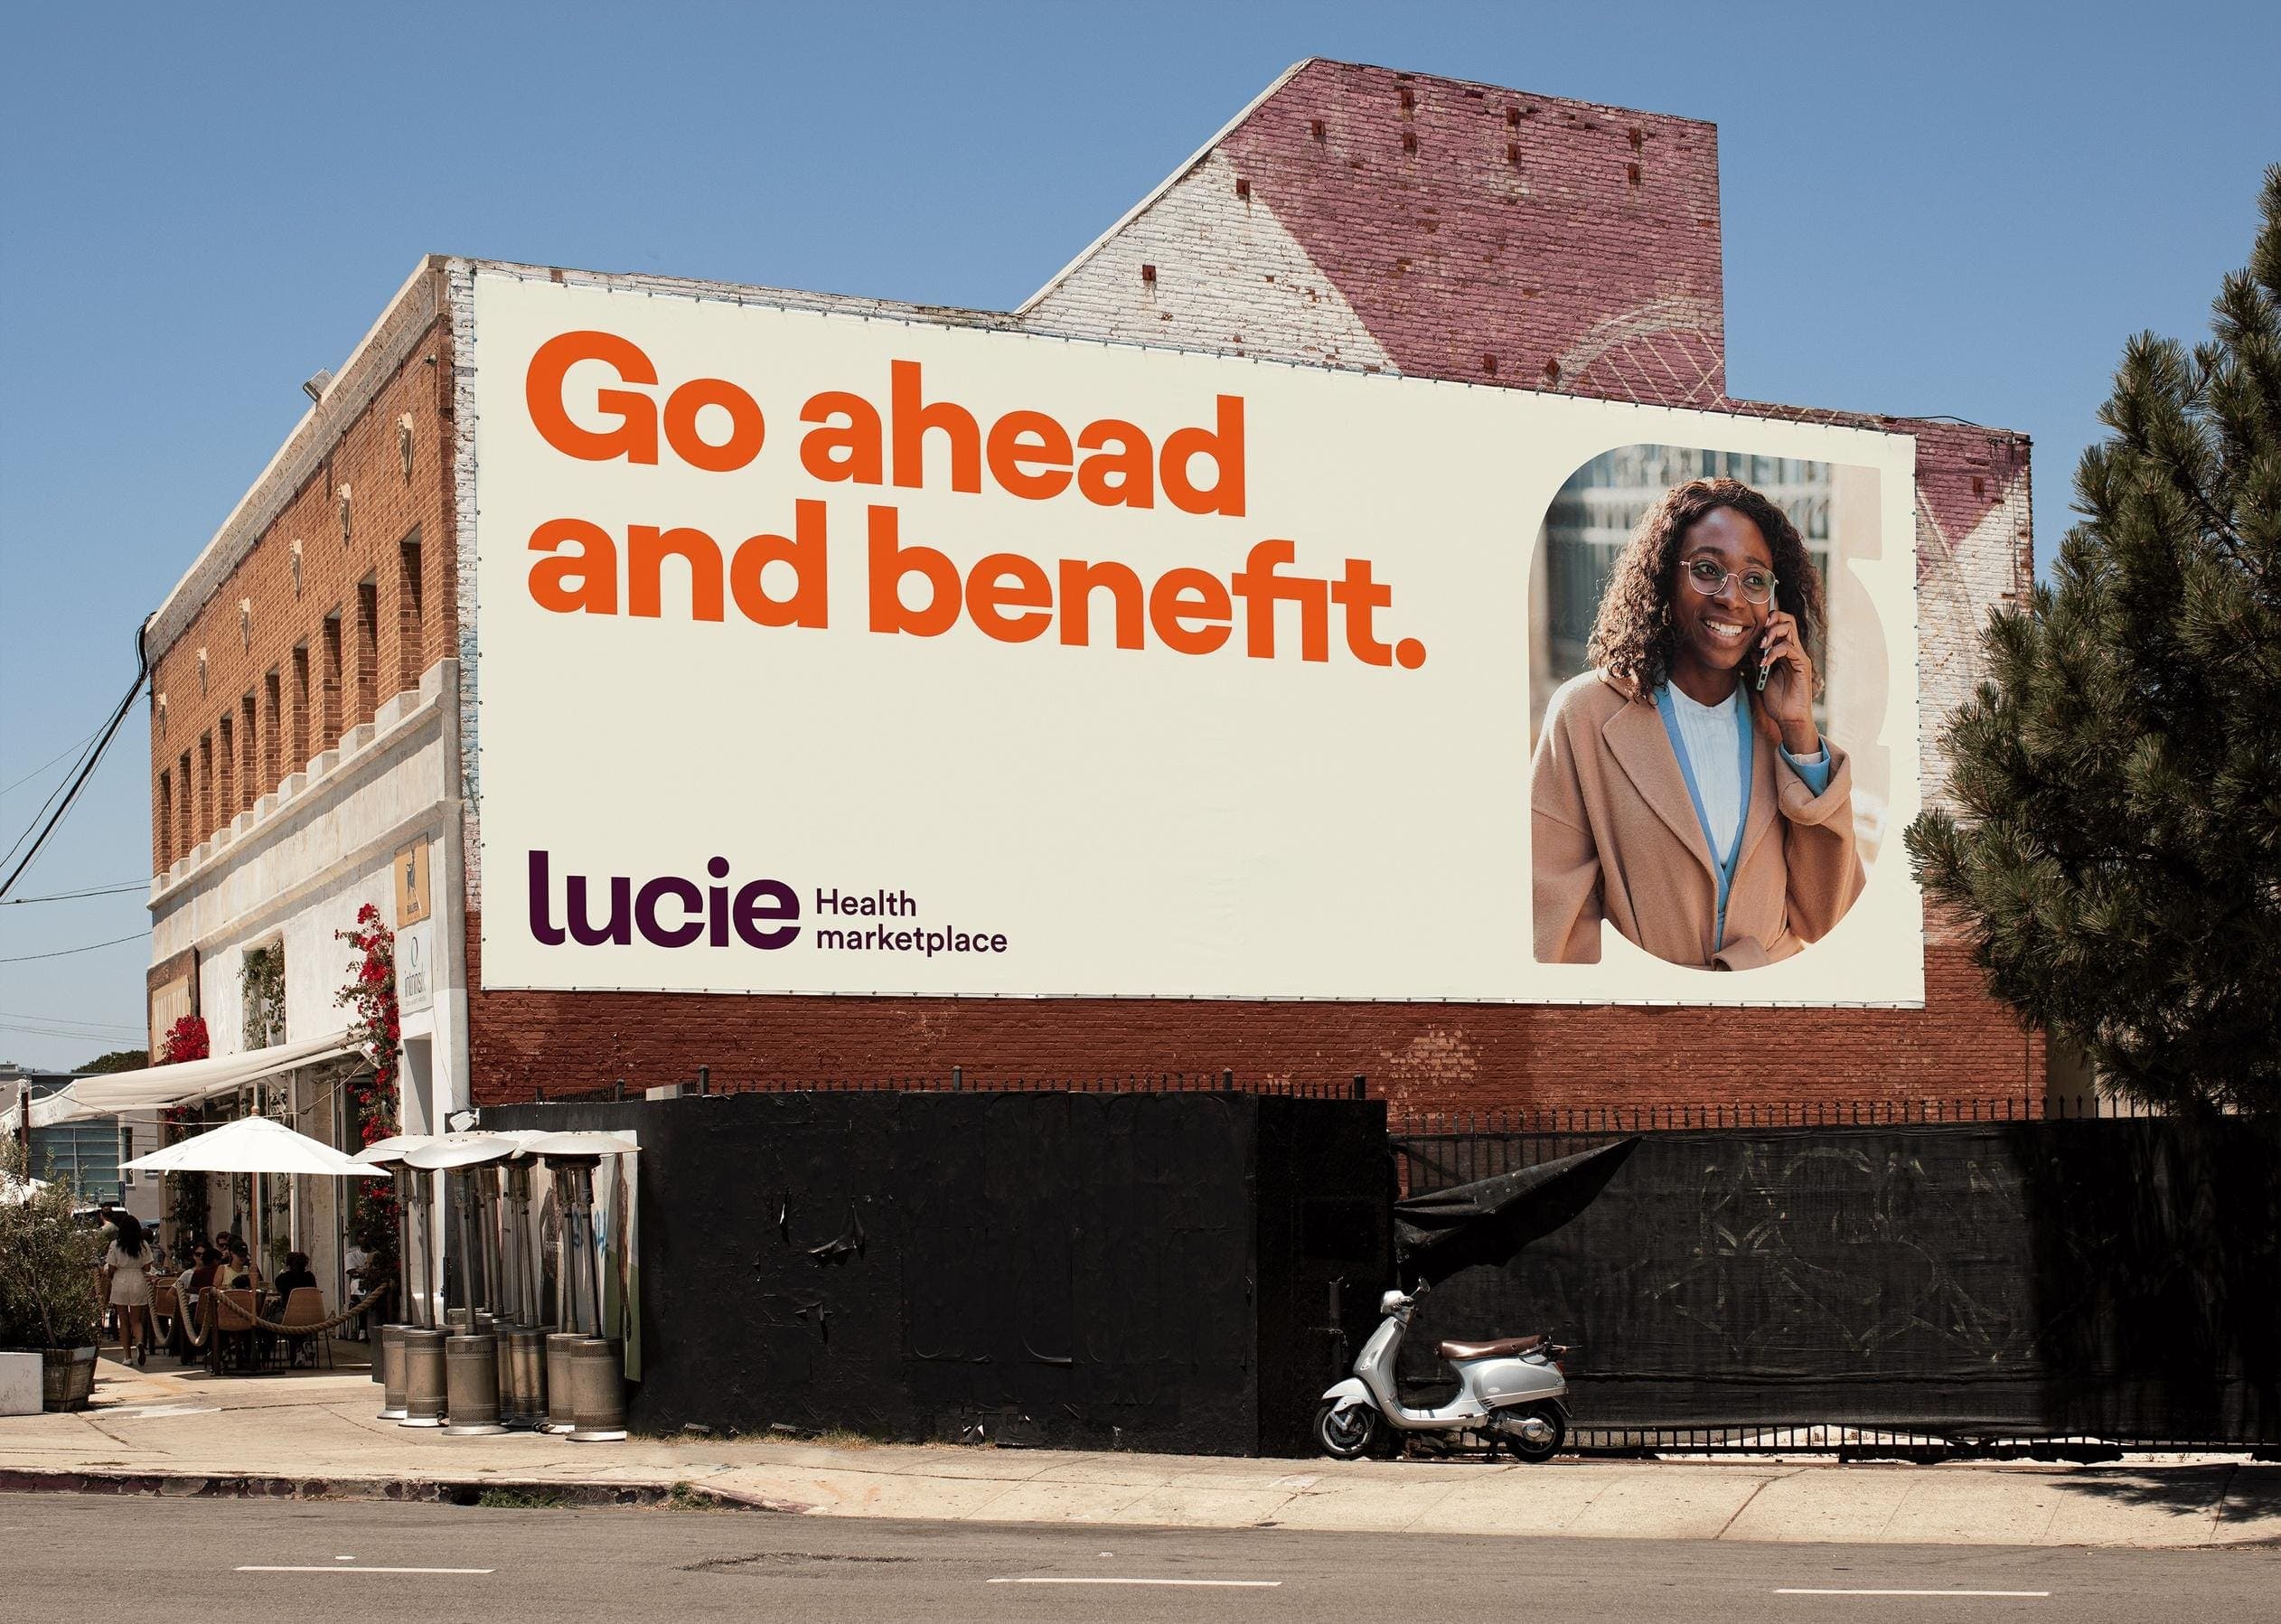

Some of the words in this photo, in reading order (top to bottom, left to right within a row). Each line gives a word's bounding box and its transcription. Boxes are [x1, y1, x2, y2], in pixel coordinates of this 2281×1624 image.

[526, 331, 765, 472] Go
[800, 360, 1245, 517] ahead
[529, 499, 828, 629] and
[868, 505, 1426, 669] benefit.
[529, 850, 802, 950] lucie
[816, 888, 916, 916] Health
[817, 924, 1008, 957] marketplace
